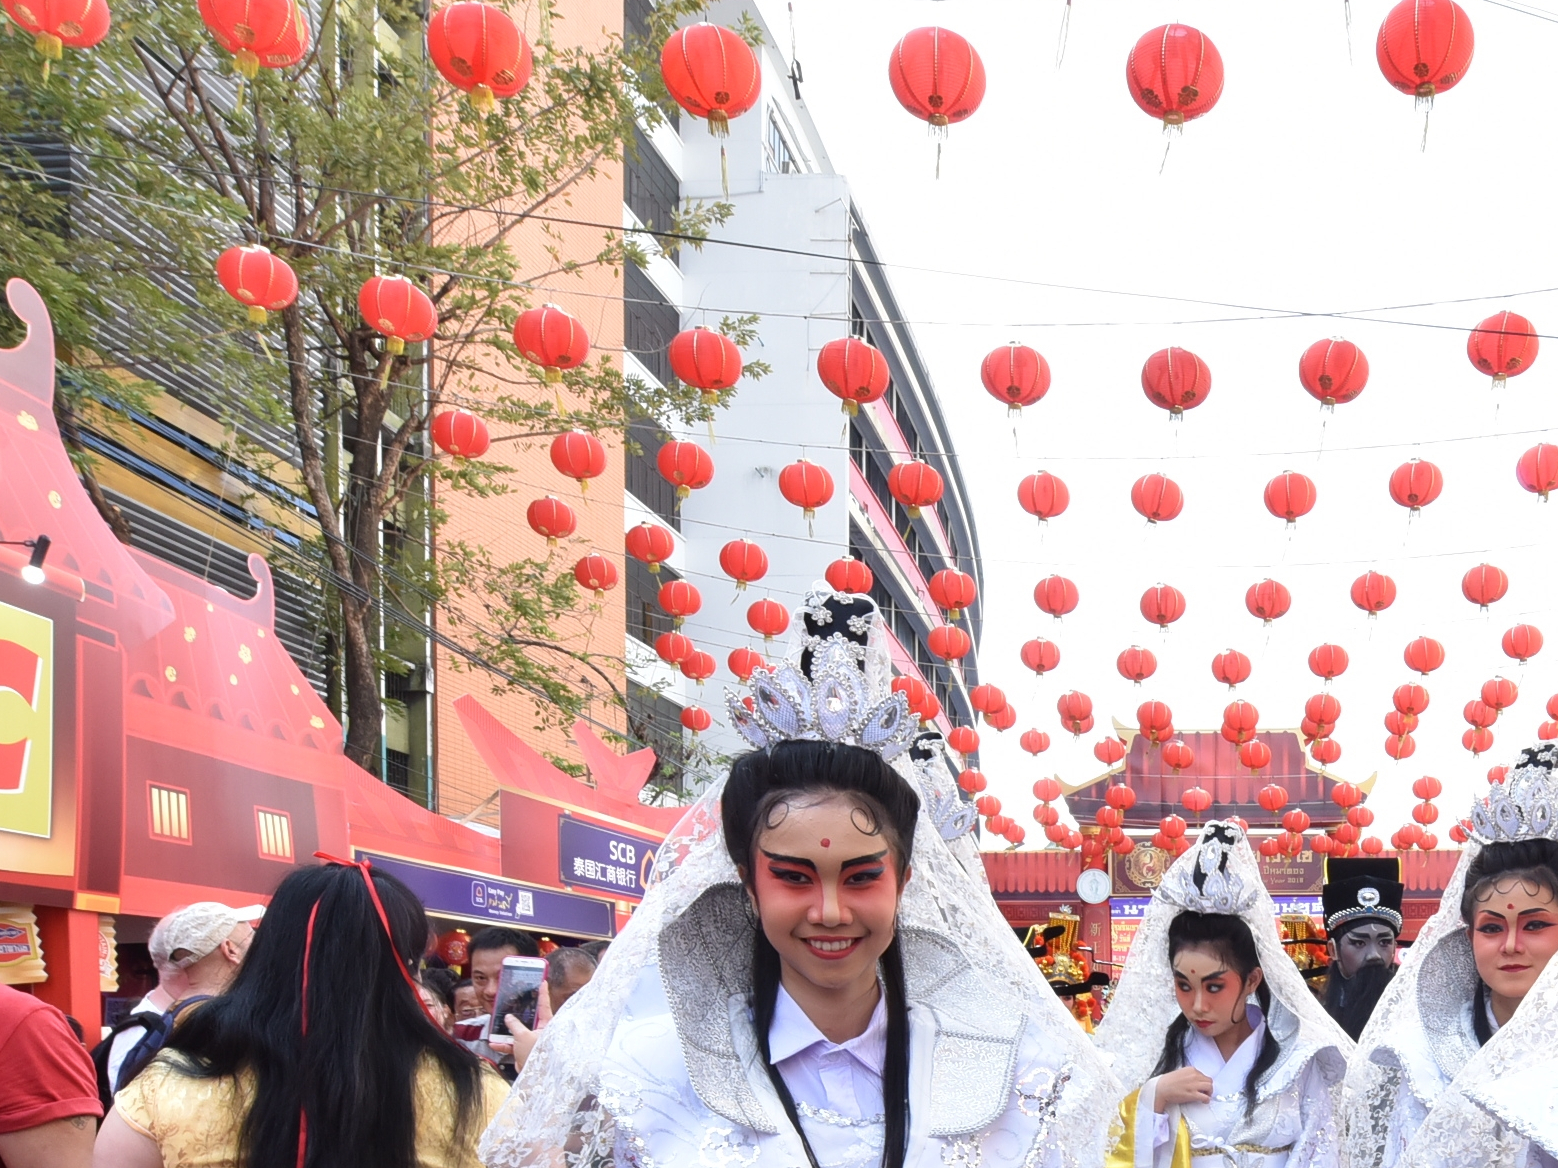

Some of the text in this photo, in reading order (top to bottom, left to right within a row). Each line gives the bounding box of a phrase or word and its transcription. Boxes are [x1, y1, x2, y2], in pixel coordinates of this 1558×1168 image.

[609, 840, 636, 864] SCB
[573, 856, 637, 889] 泰国汇商银行
